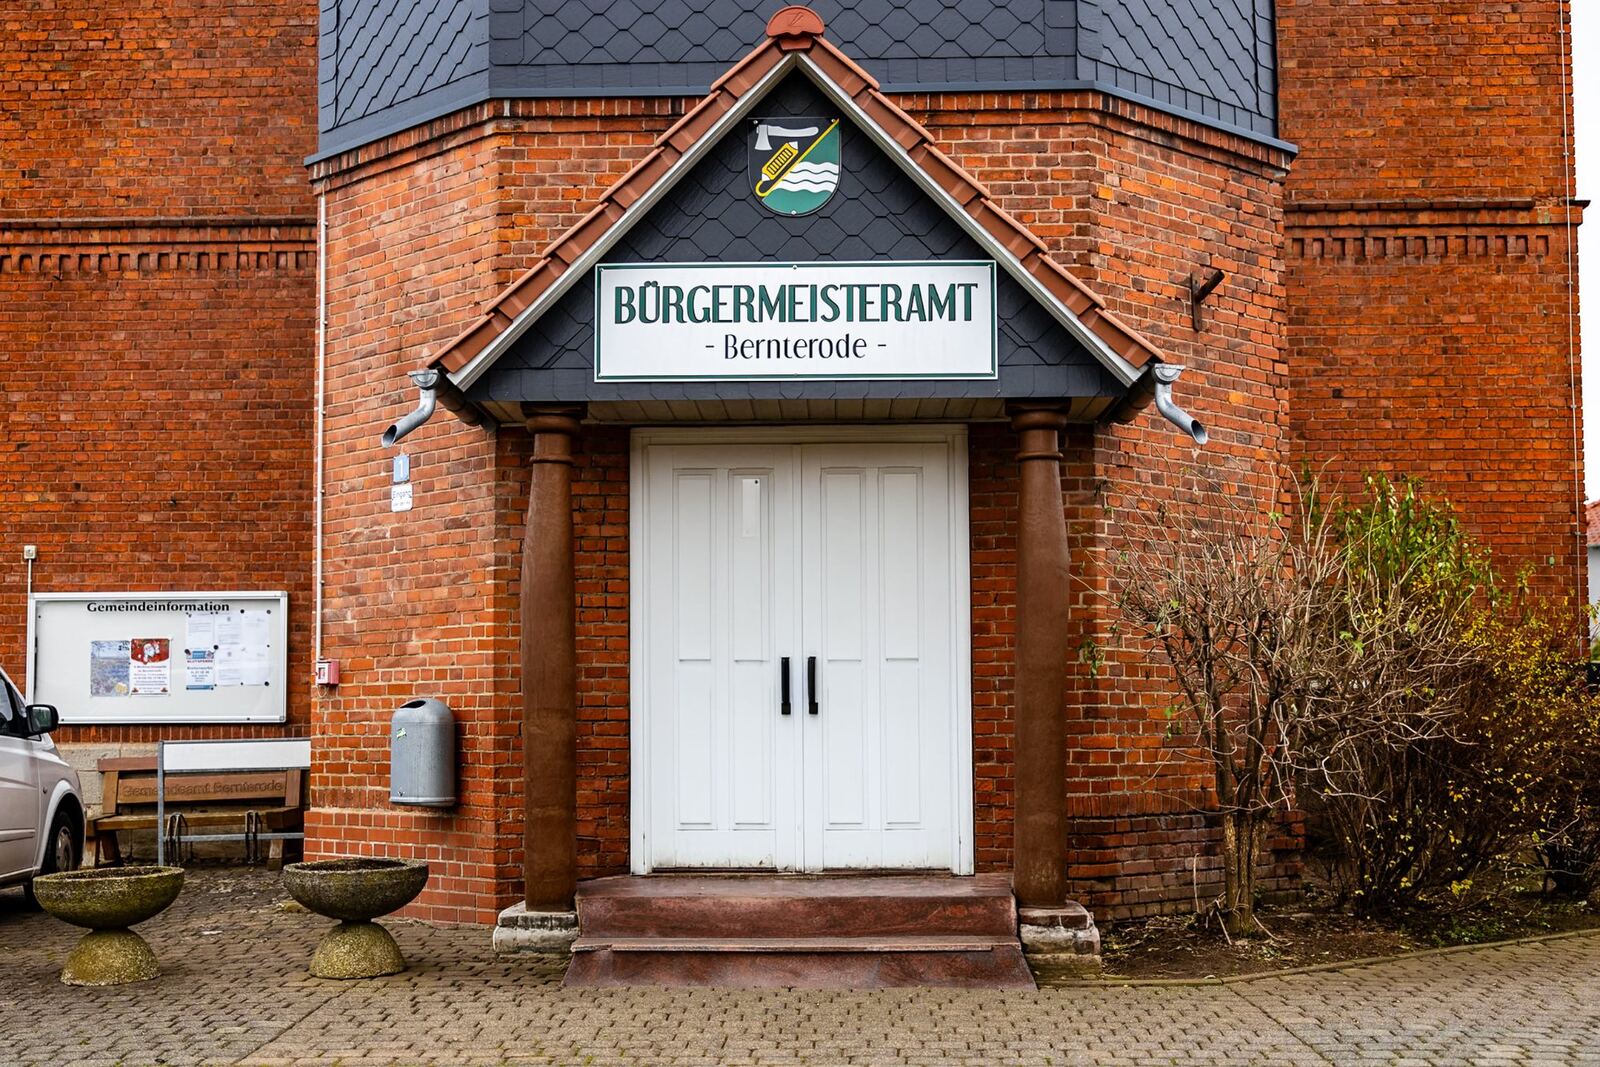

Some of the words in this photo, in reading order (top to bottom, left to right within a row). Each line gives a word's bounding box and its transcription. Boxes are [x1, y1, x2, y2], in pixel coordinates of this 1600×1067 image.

[614, 280, 978, 324] BÜRGERMEISTERAMT
[724, 333, 867, 360] Bernterode
[86, 601, 230, 612] Gemeindeinformation
[123, 784, 211, 797] Gemendeamt
[213, 780, 283, 794] Bernterode
